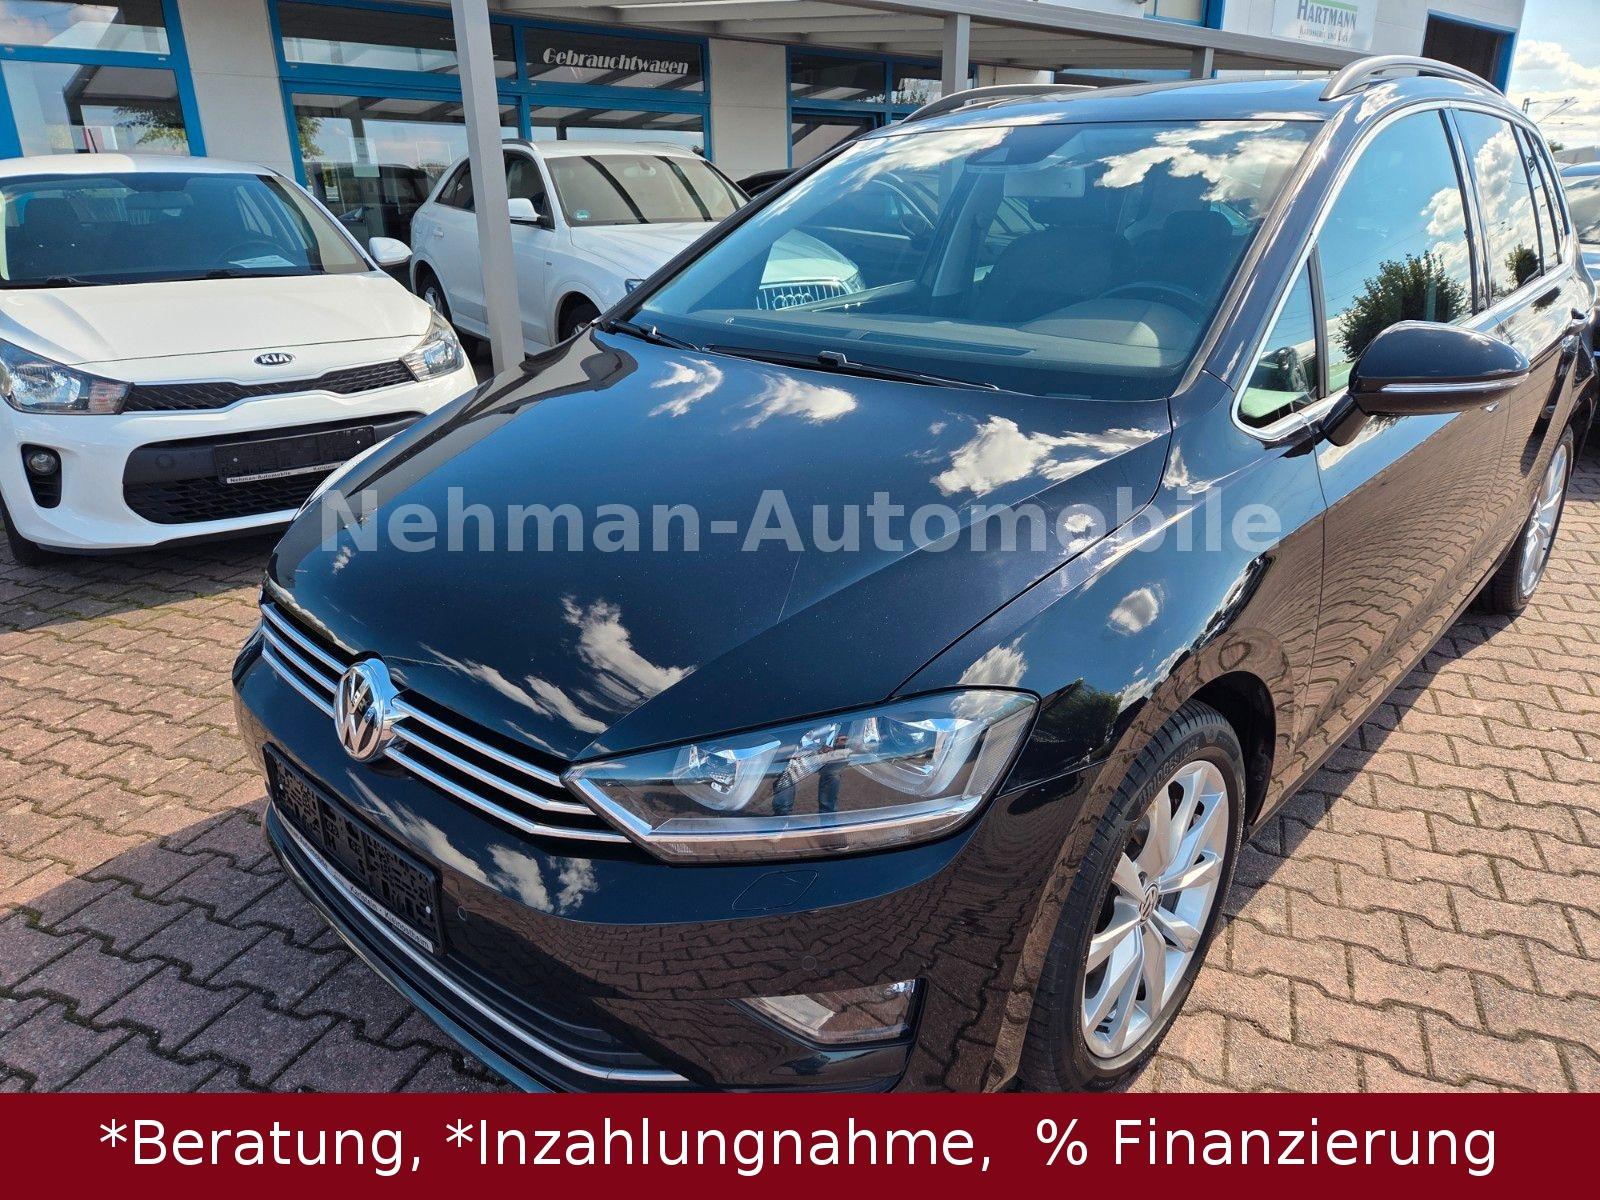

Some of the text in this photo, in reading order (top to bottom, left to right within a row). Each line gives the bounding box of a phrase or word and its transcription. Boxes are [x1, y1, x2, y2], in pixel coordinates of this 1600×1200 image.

[1297, 0, 1357, 30] HARTMANN
[542, 47, 689, 75] Gebrauchtwagen
[258, 353, 291, 364] KIA
